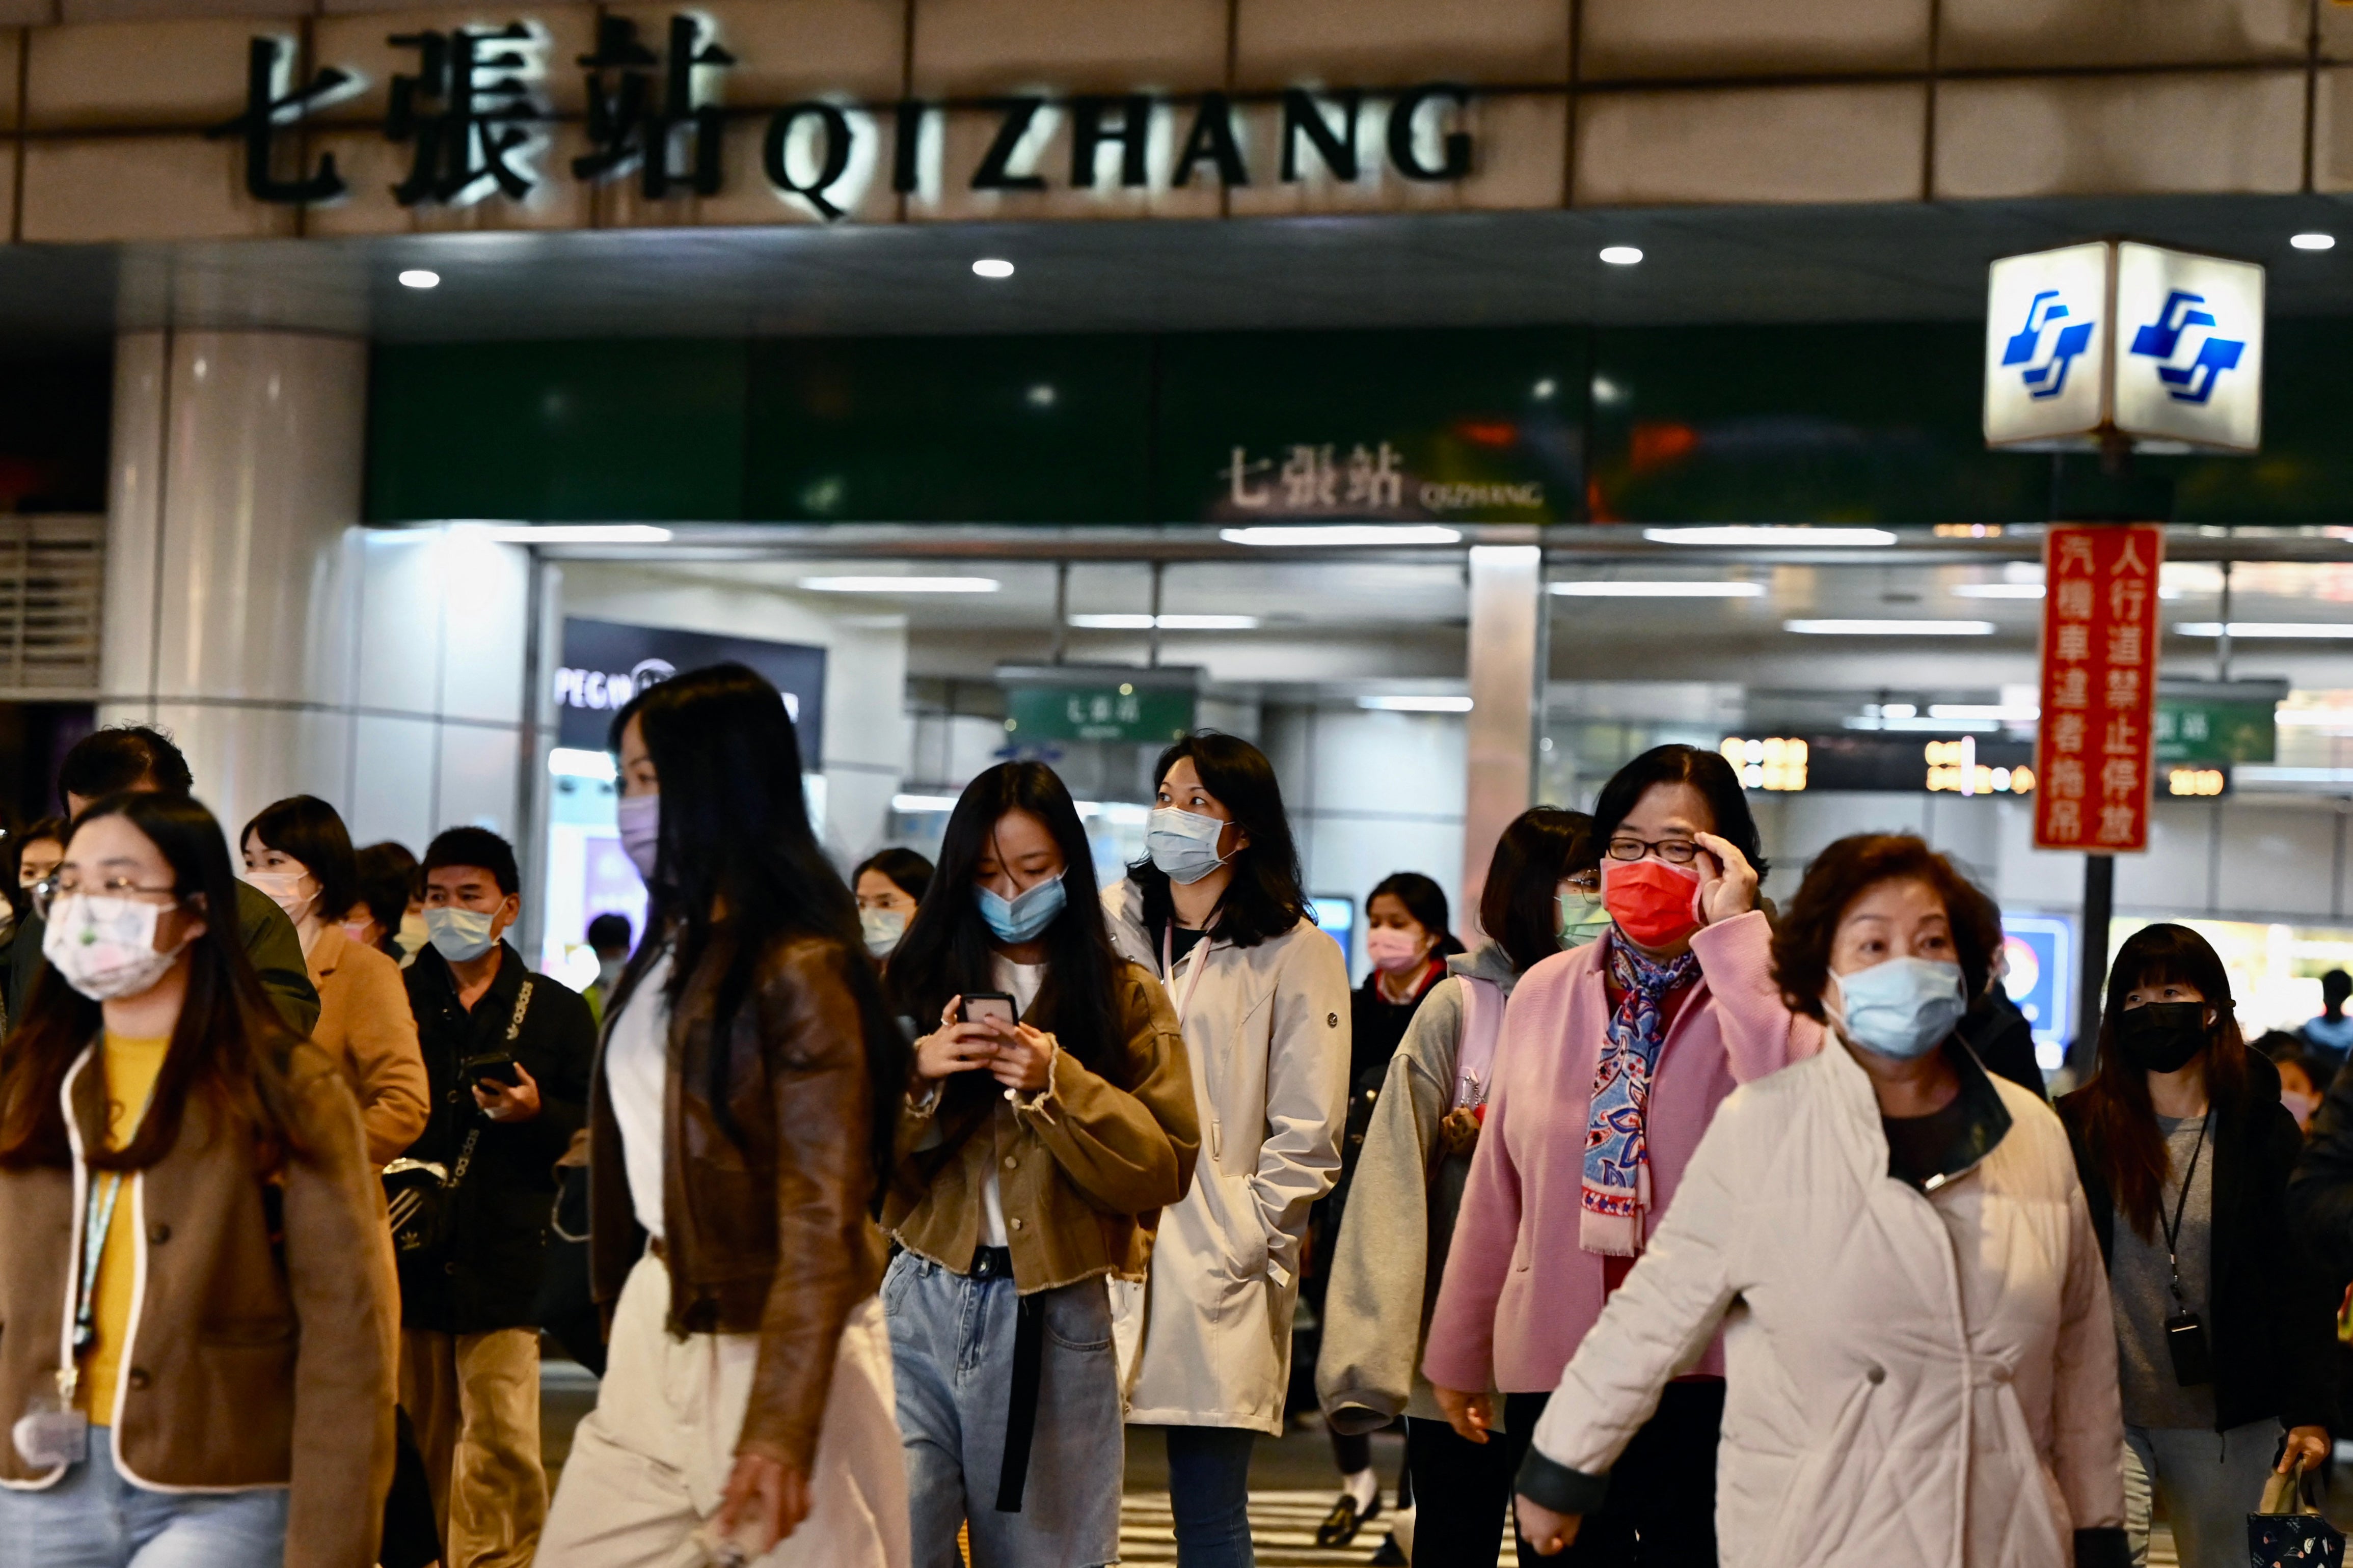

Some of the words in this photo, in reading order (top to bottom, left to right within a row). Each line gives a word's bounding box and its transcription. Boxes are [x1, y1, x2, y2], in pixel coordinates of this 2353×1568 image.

[205, 13, 737, 205] 七張站
[763, 81, 1473, 221] QIZHANG
[1218, 442, 1403, 509] 七張站
[2097, 534, 2148, 843] 人行道禁止停放
[512, 980, 533, 1024] adidas
